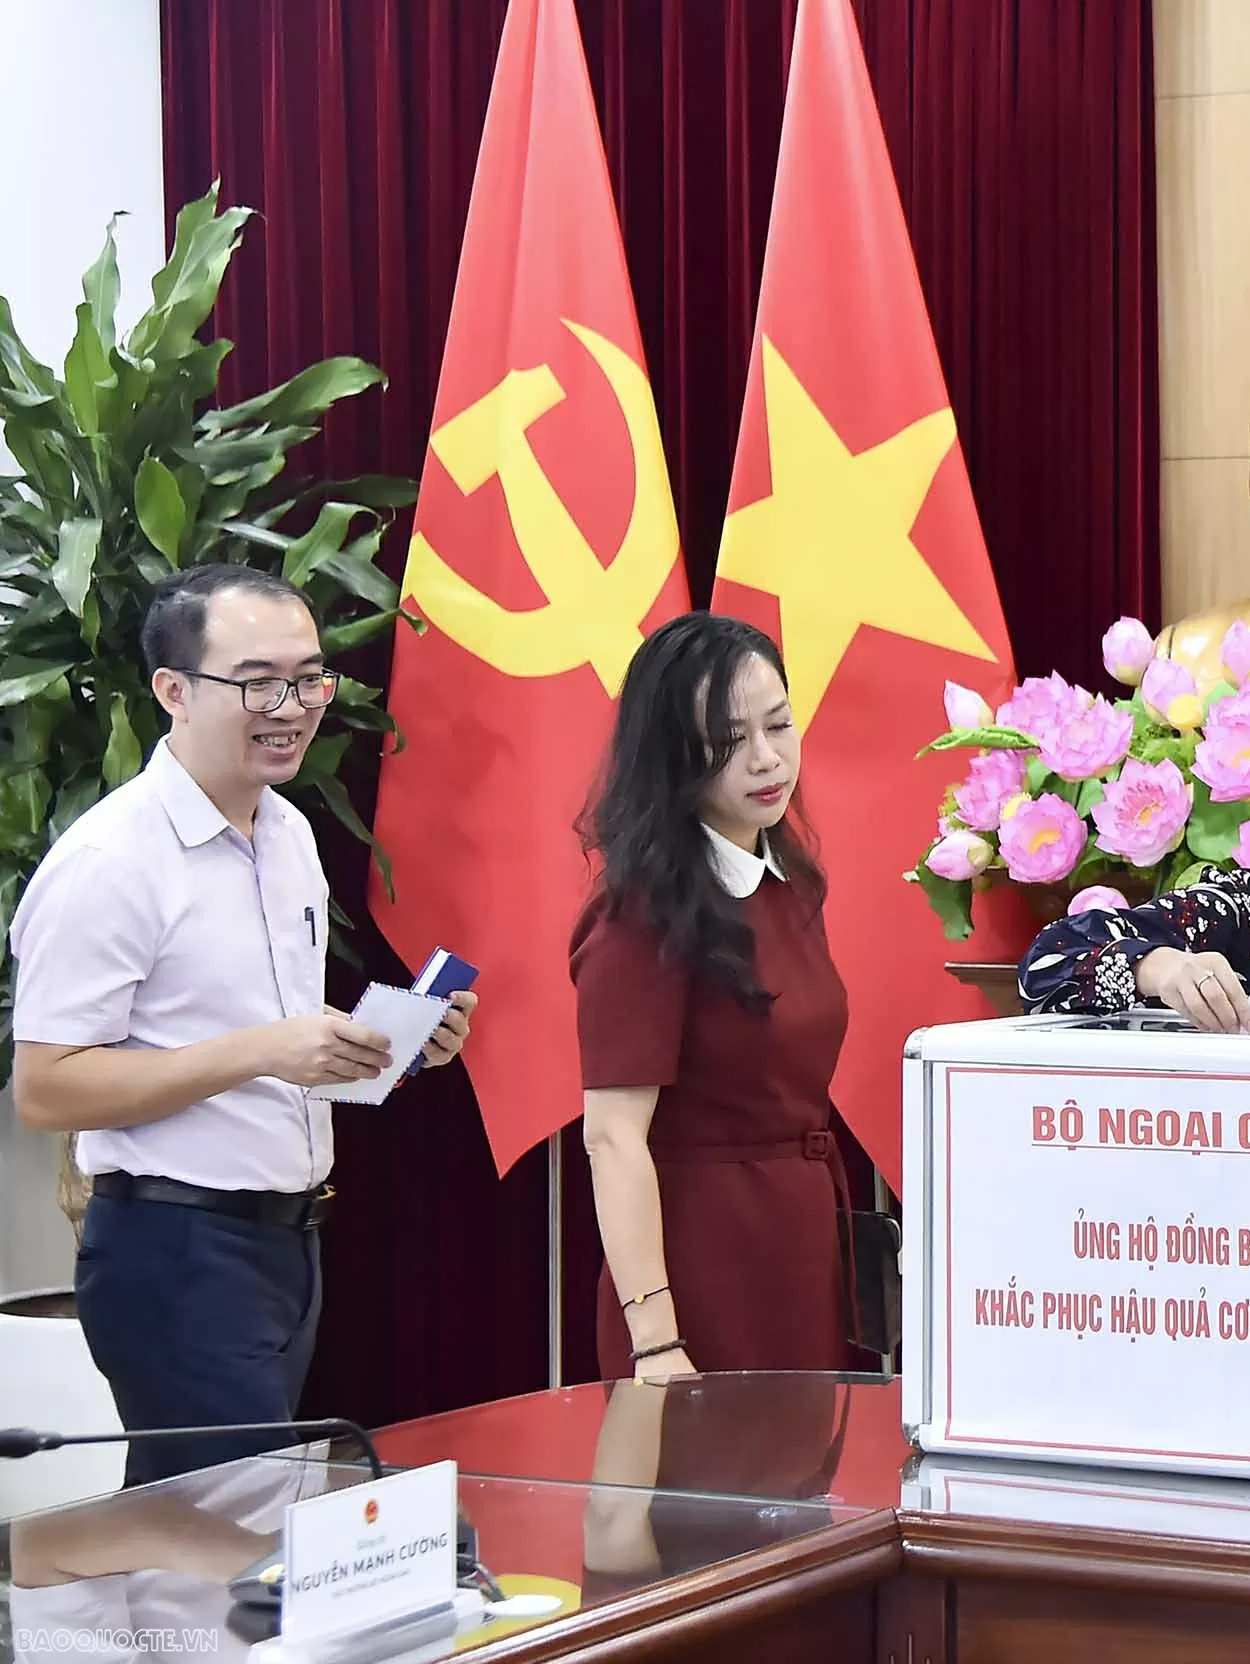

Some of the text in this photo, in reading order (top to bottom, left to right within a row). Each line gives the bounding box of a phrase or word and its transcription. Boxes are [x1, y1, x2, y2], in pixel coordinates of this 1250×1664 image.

[1031, 1098, 1084, 1151] BỘ
[1098, 1106, 1223, 1156] NGOẠI
[1073, 1207, 1120, 1261] ỦNG
[1128, 1215, 1158, 1271] HỘ
[1166, 1212, 1231, 1267] ĐỒNG
[975, 1276, 1035, 1329] KHẮC
[1042, 1292, 1103, 1341] PHỤC
[1110, 1288, 1157, 1344] HẬU
[1164, 1286, 1211, 1342] QUẢ
